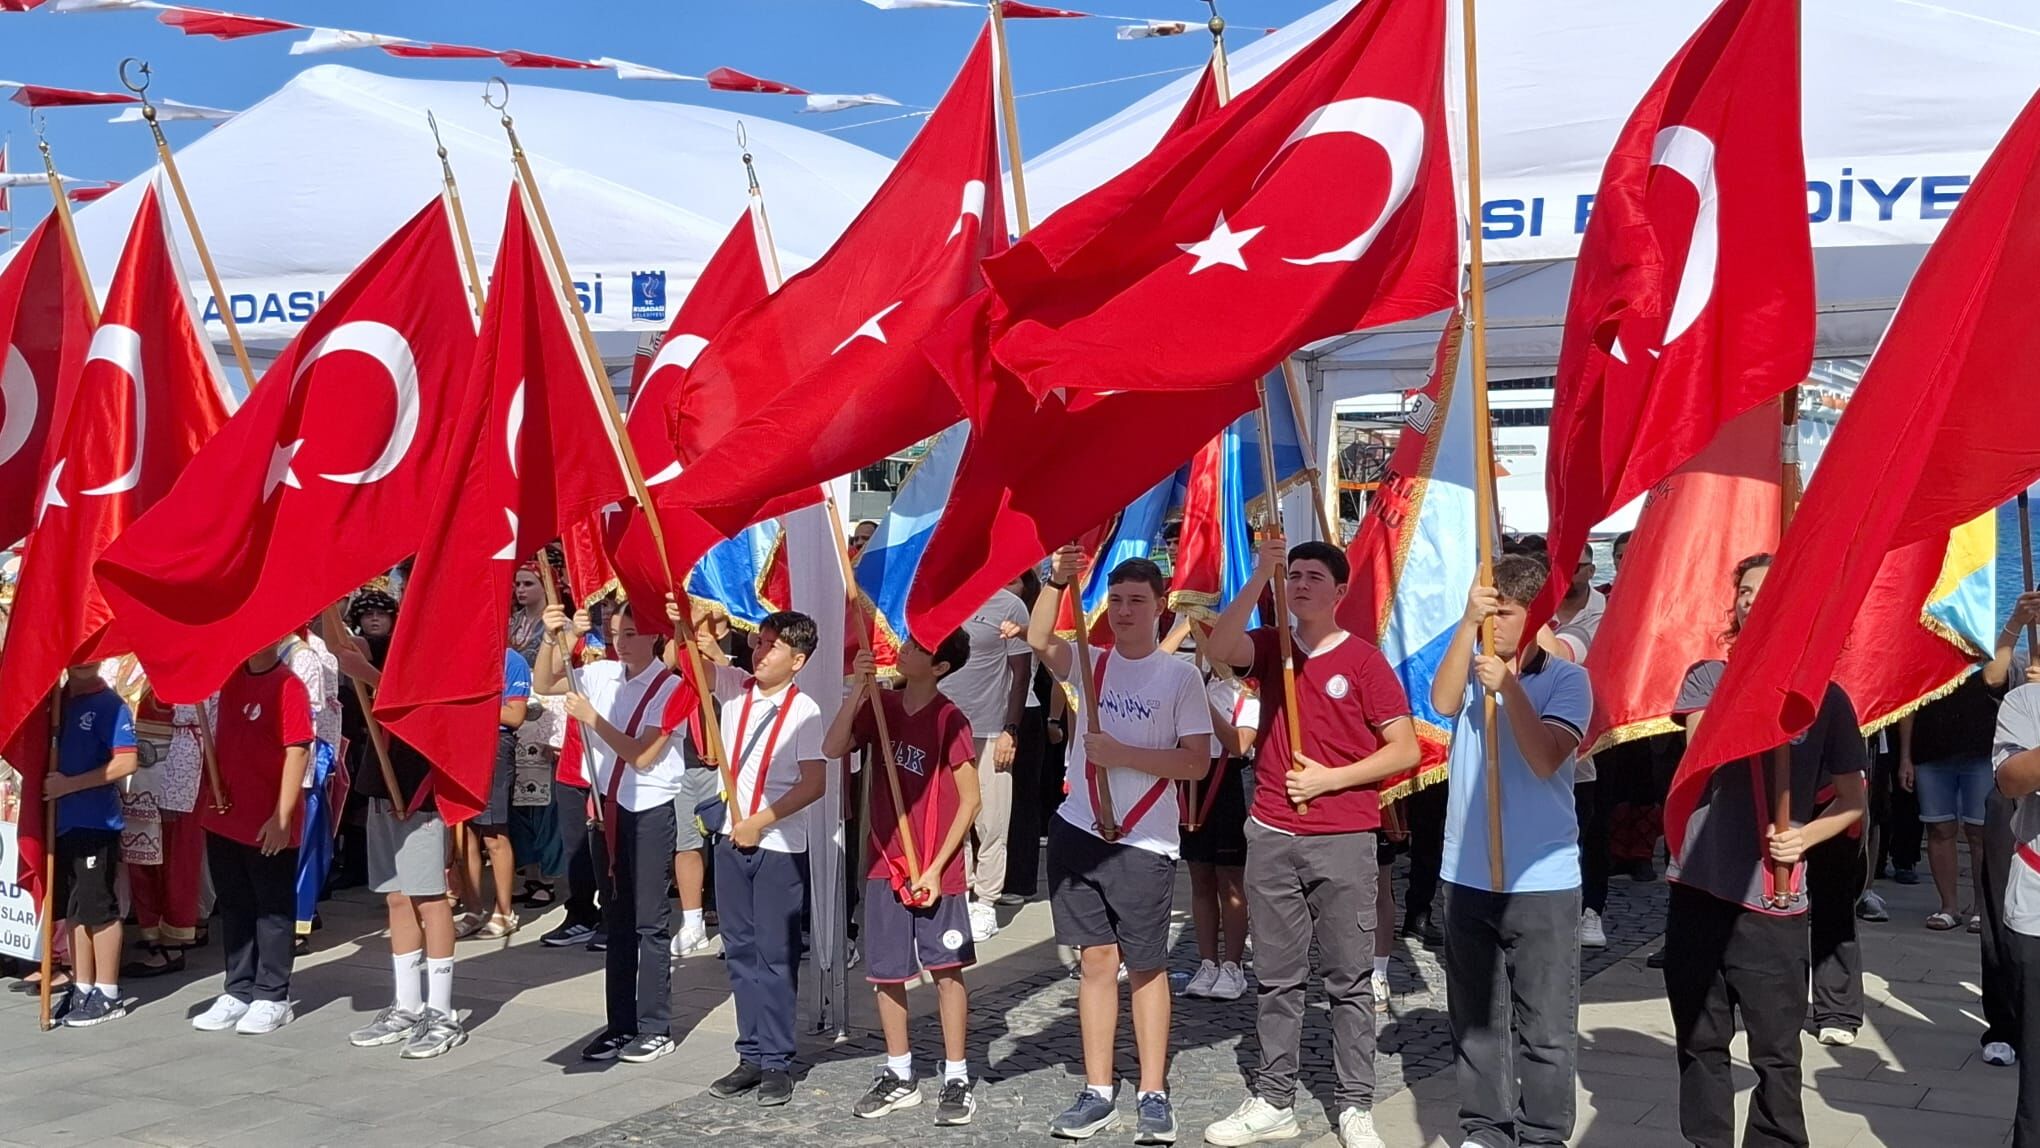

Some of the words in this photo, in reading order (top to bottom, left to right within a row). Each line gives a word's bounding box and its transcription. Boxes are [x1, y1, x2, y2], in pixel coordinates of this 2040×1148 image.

[1480, 197, 1545, 240] SI
[202, 290, 326, 325] ADASI
[882, 740, 927, 777] AK
[0, 881, 21, 899] AD
[0, 905, 35, 926] SLAR
